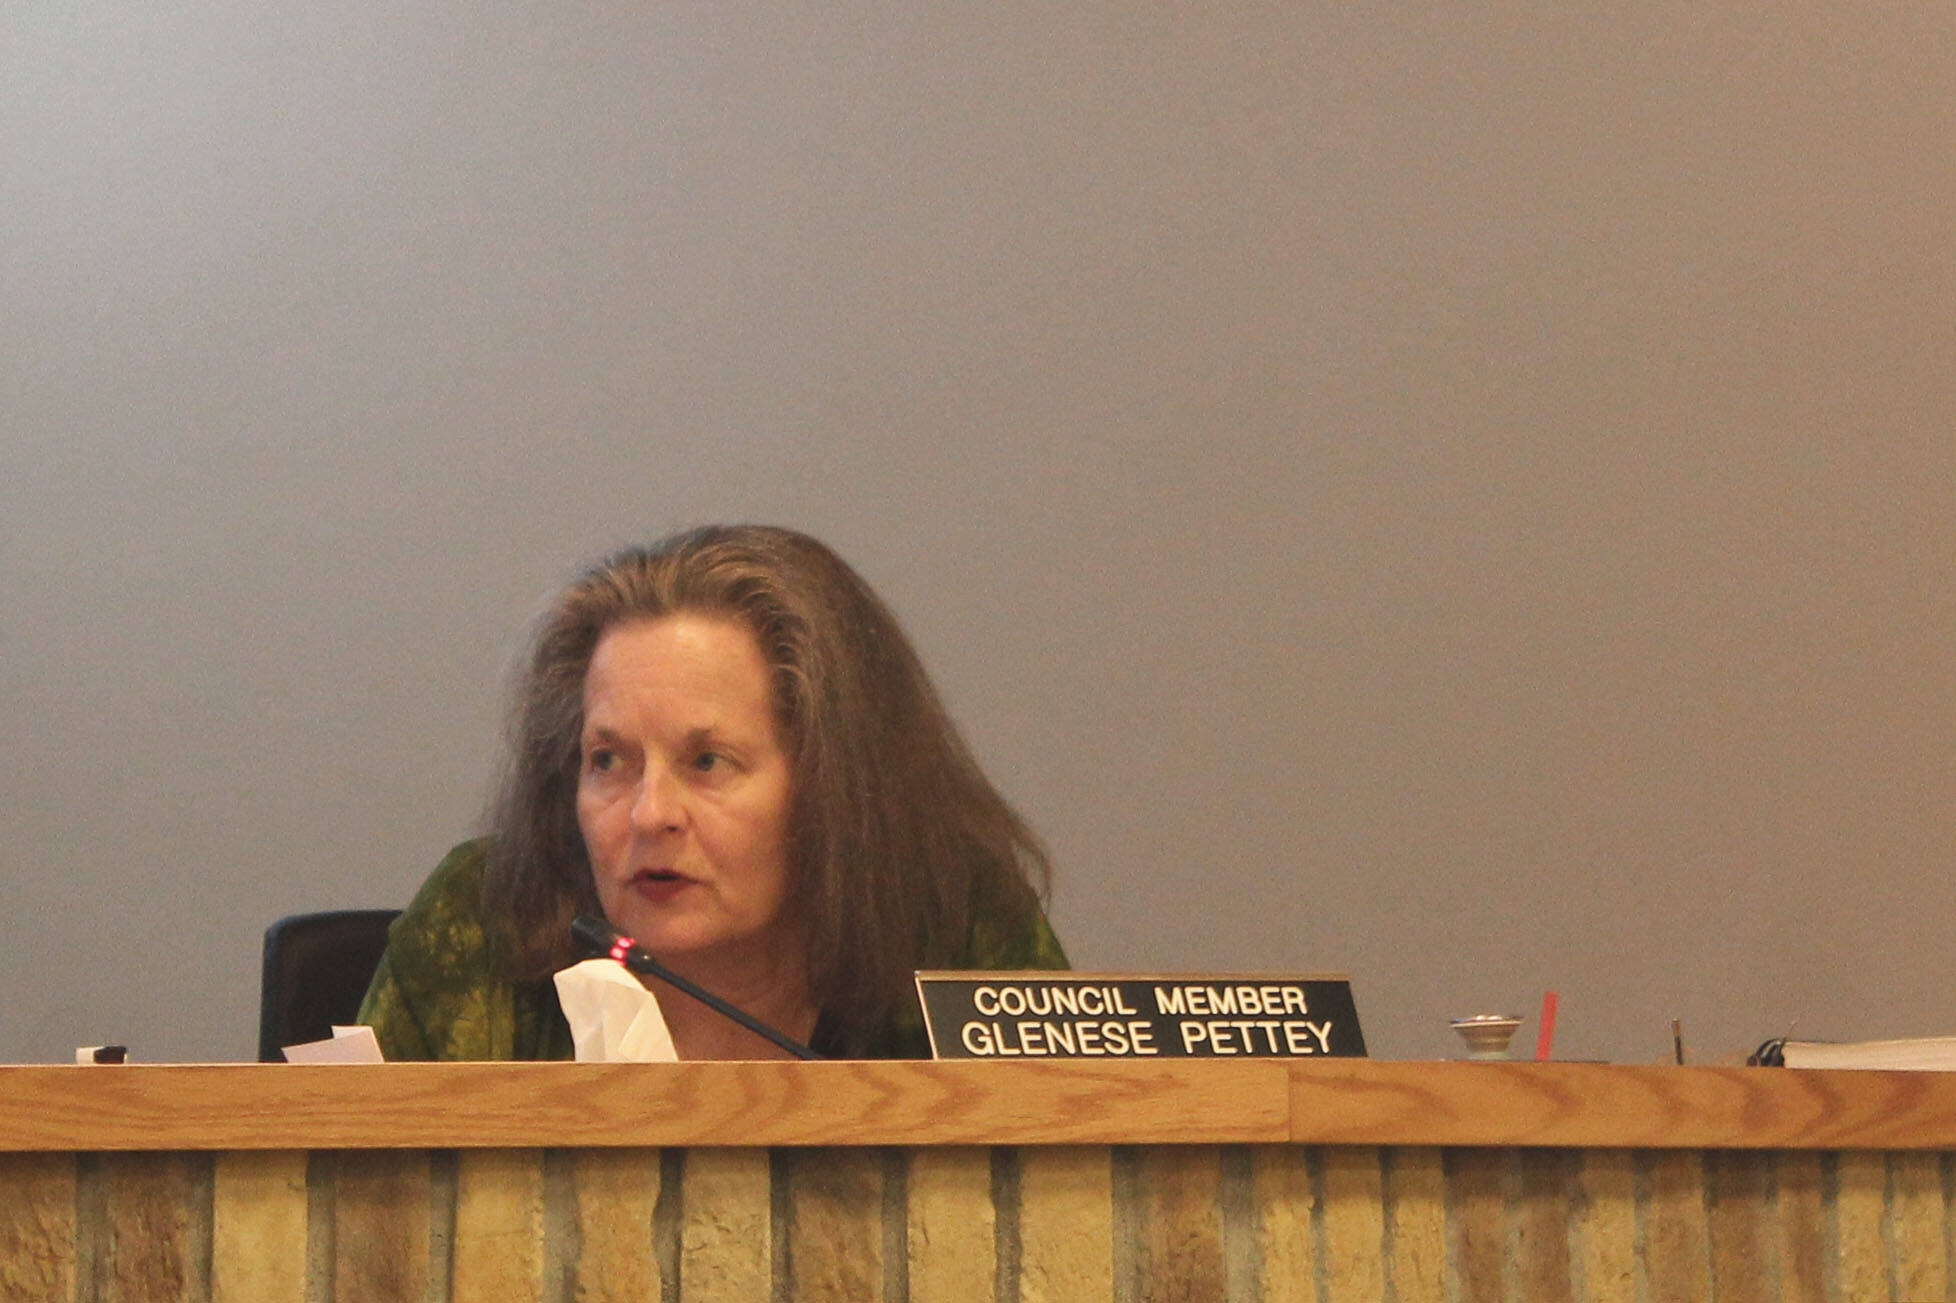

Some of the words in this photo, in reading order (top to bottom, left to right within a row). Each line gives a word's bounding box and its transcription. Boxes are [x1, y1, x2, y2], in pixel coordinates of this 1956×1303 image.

[973, 986, 1136, 1017] COUNCIL
[1154, 986, 1307, 1016] MEMBER
[961, 1020, 1158, 1056] GLENESE
[1180, 1020, 1333, 1055] PETTEY
